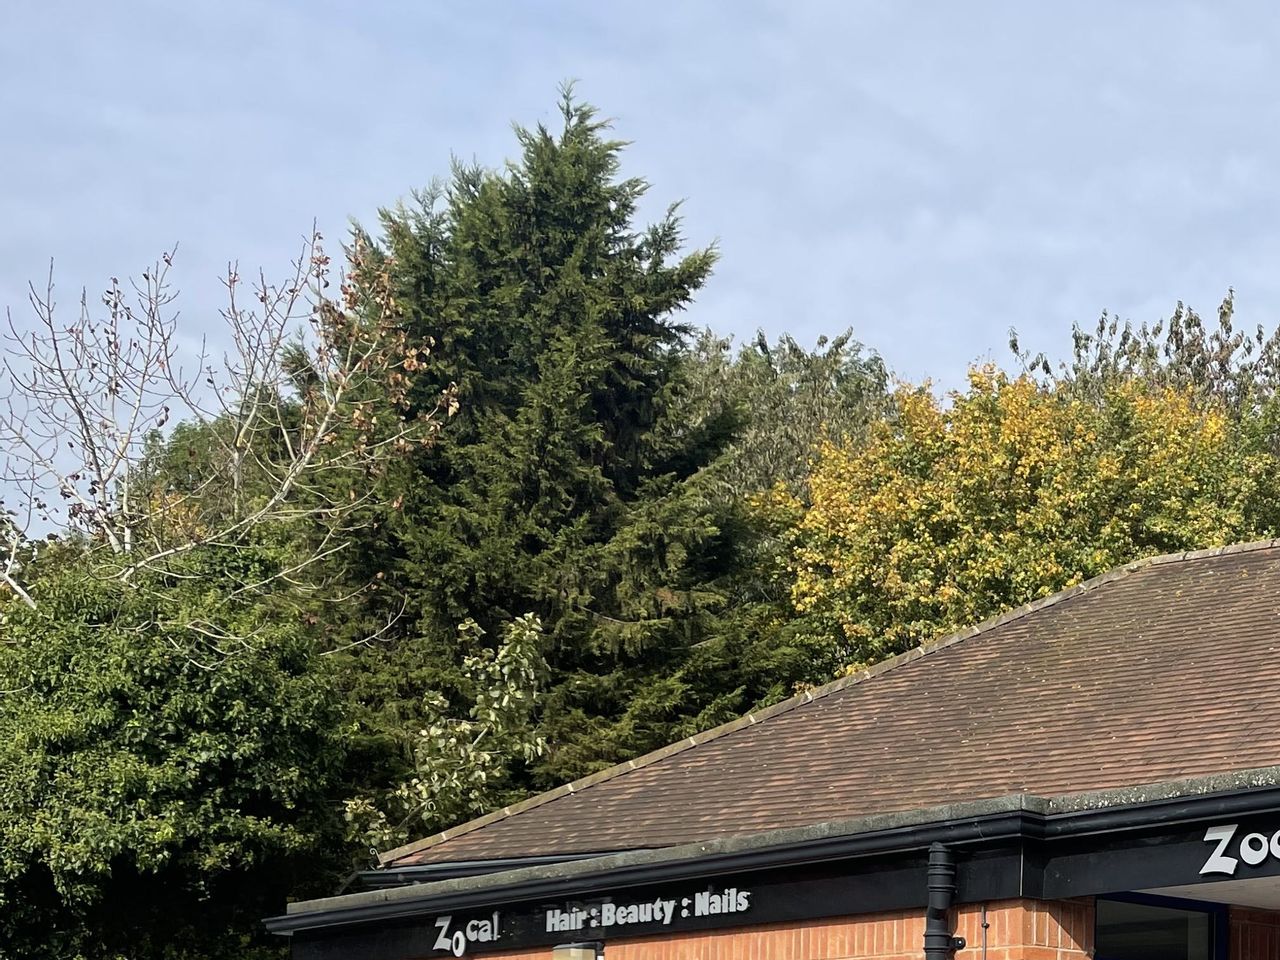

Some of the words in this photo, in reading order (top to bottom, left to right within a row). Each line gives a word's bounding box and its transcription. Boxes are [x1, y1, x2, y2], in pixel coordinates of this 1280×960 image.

[546, 907, 588, 932] Hair
[601, 897, 677, 926] Beauty
[694, 888, 750, 917] Nails
[432, 910, 500, 957] Zocal
